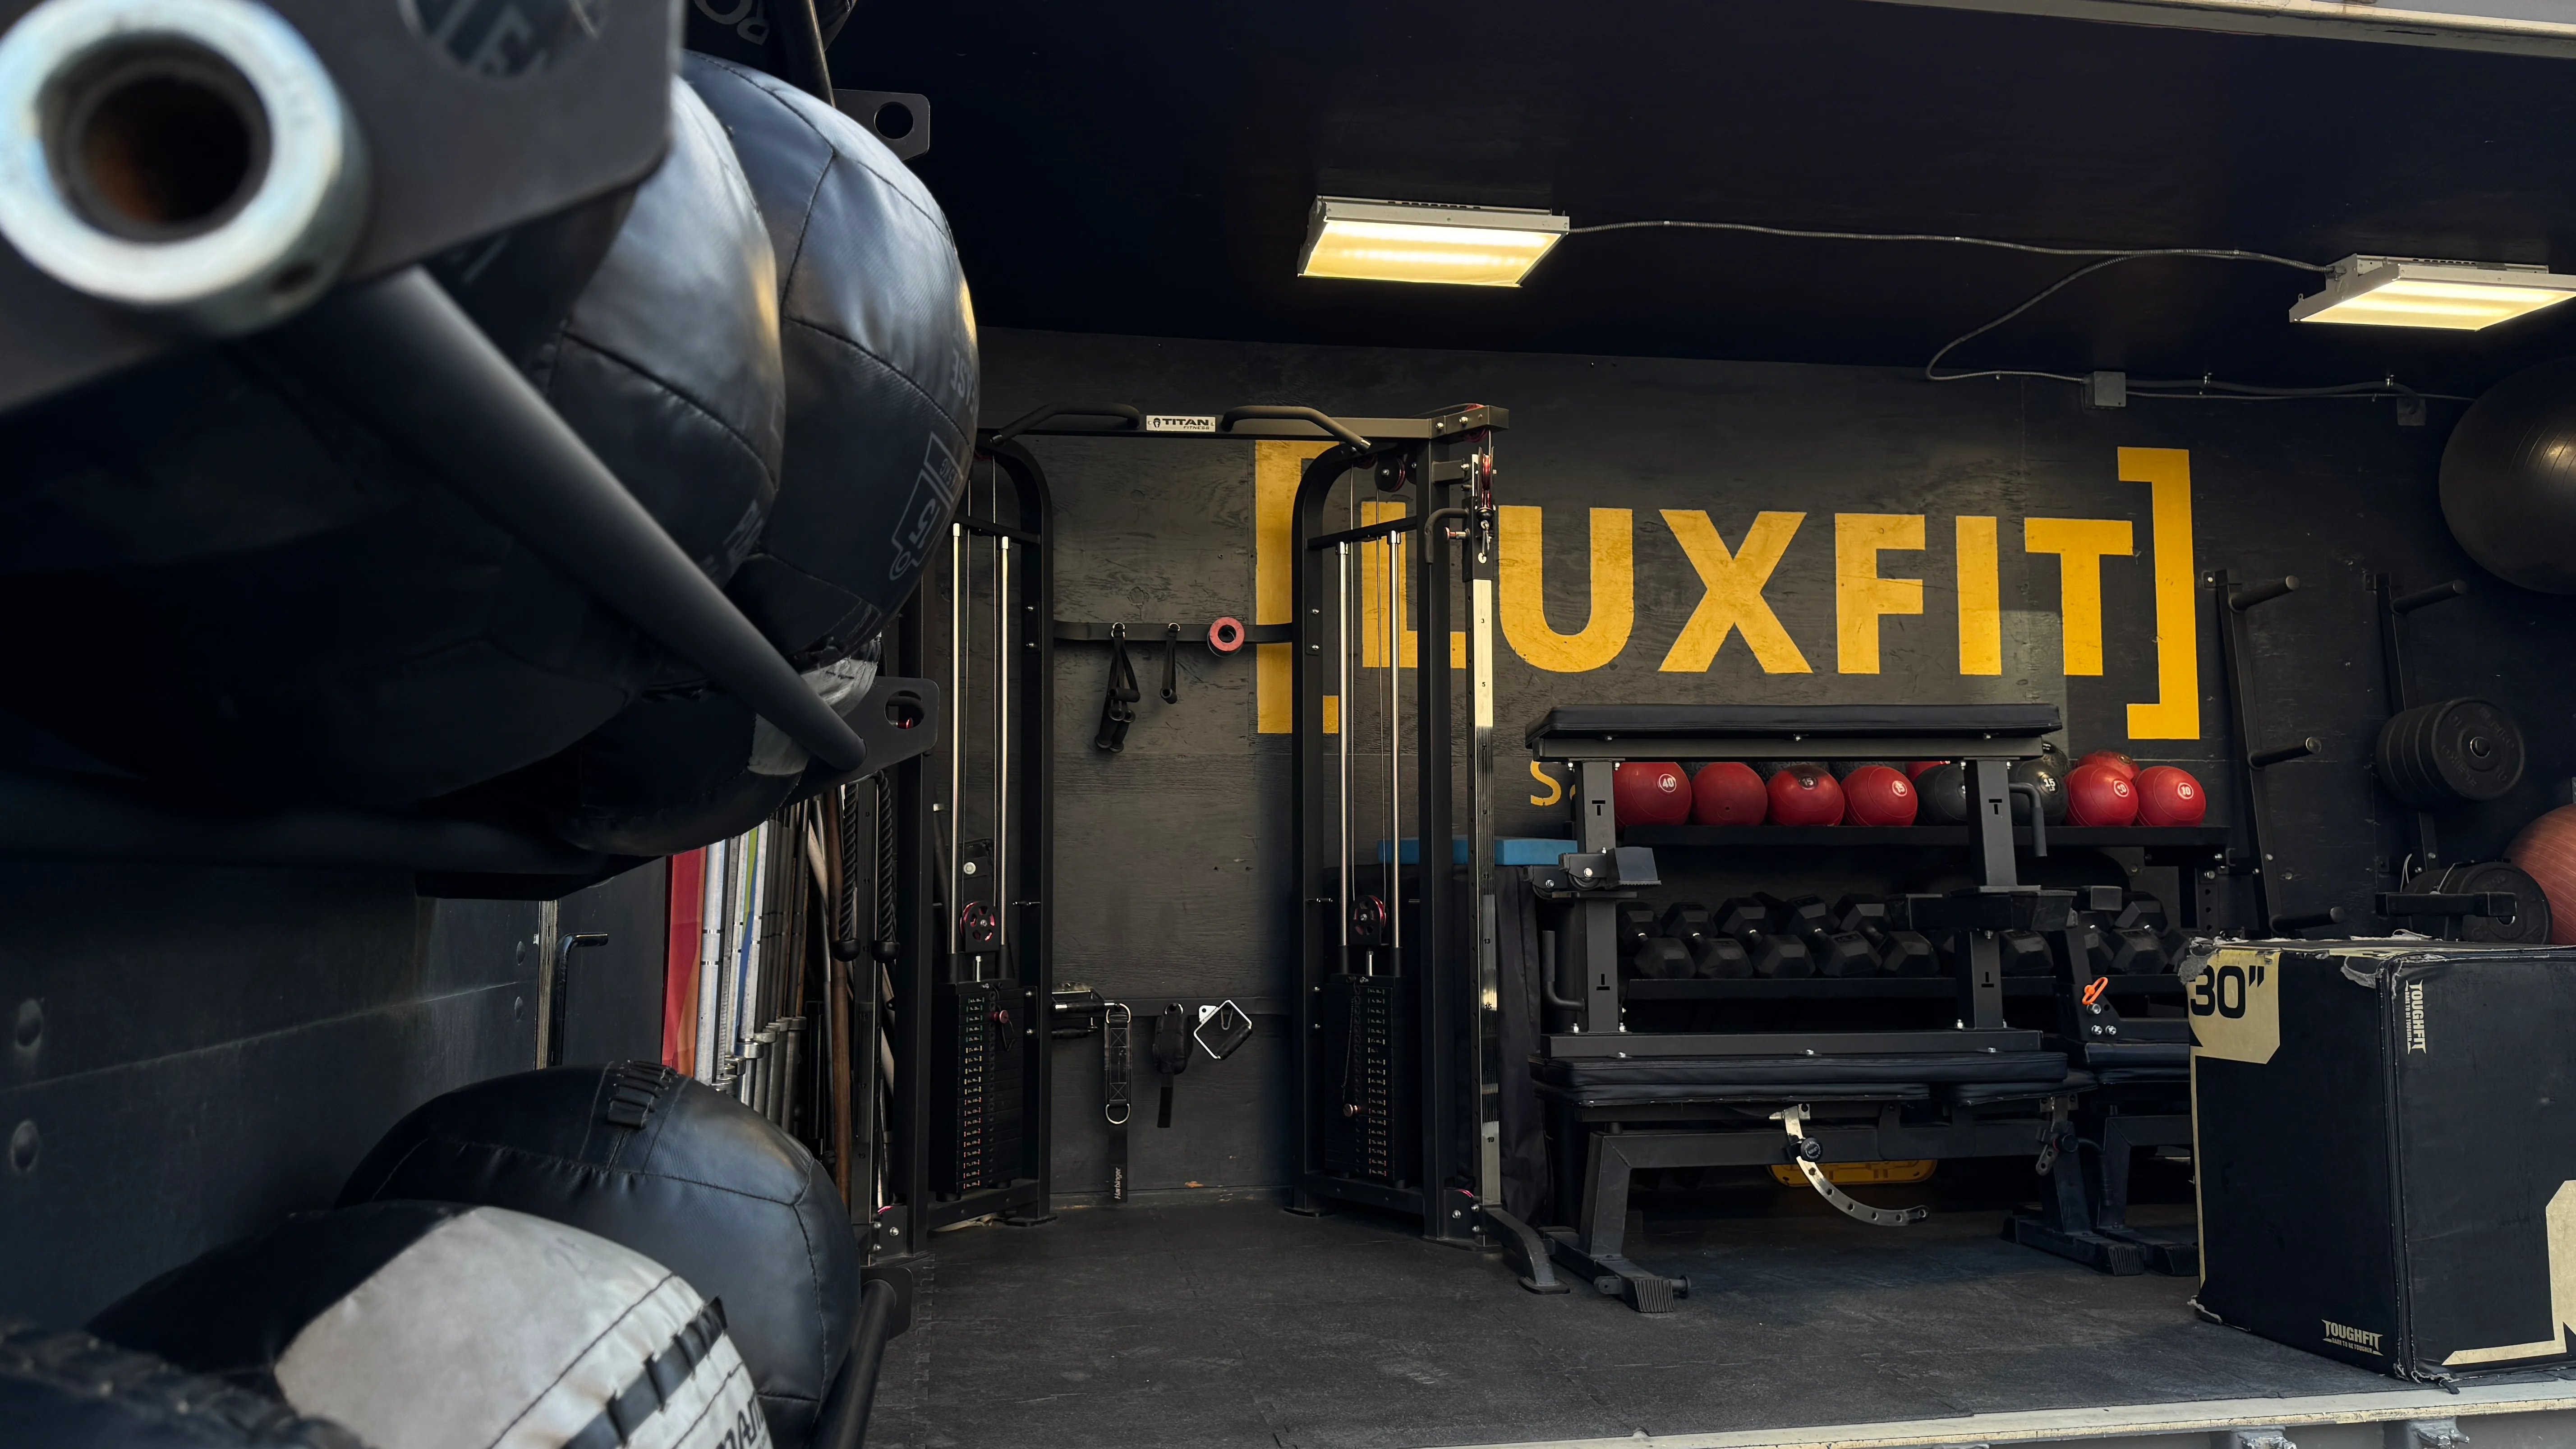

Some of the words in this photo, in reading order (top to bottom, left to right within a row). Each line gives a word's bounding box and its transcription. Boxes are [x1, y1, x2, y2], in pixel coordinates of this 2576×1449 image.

[1663, 777, 1674, 788] 40
[1802, 777, 1814, 787] 15
[1894, 782, 1905, 793] 15
[2043, 778, 2056, 787] 15
[2181, 786, 2191, 796] 10
[2189, 964, 2264, 1019] 30"
[2409, 979, 2426, 1054] TOUGHFIT
[1113, 1167, 1122, 1200] Harbinger
[2321, 1319, 2383, 1351] TOUGHFIT
[2353, 1344, 2373, 1353] TOUGHER
